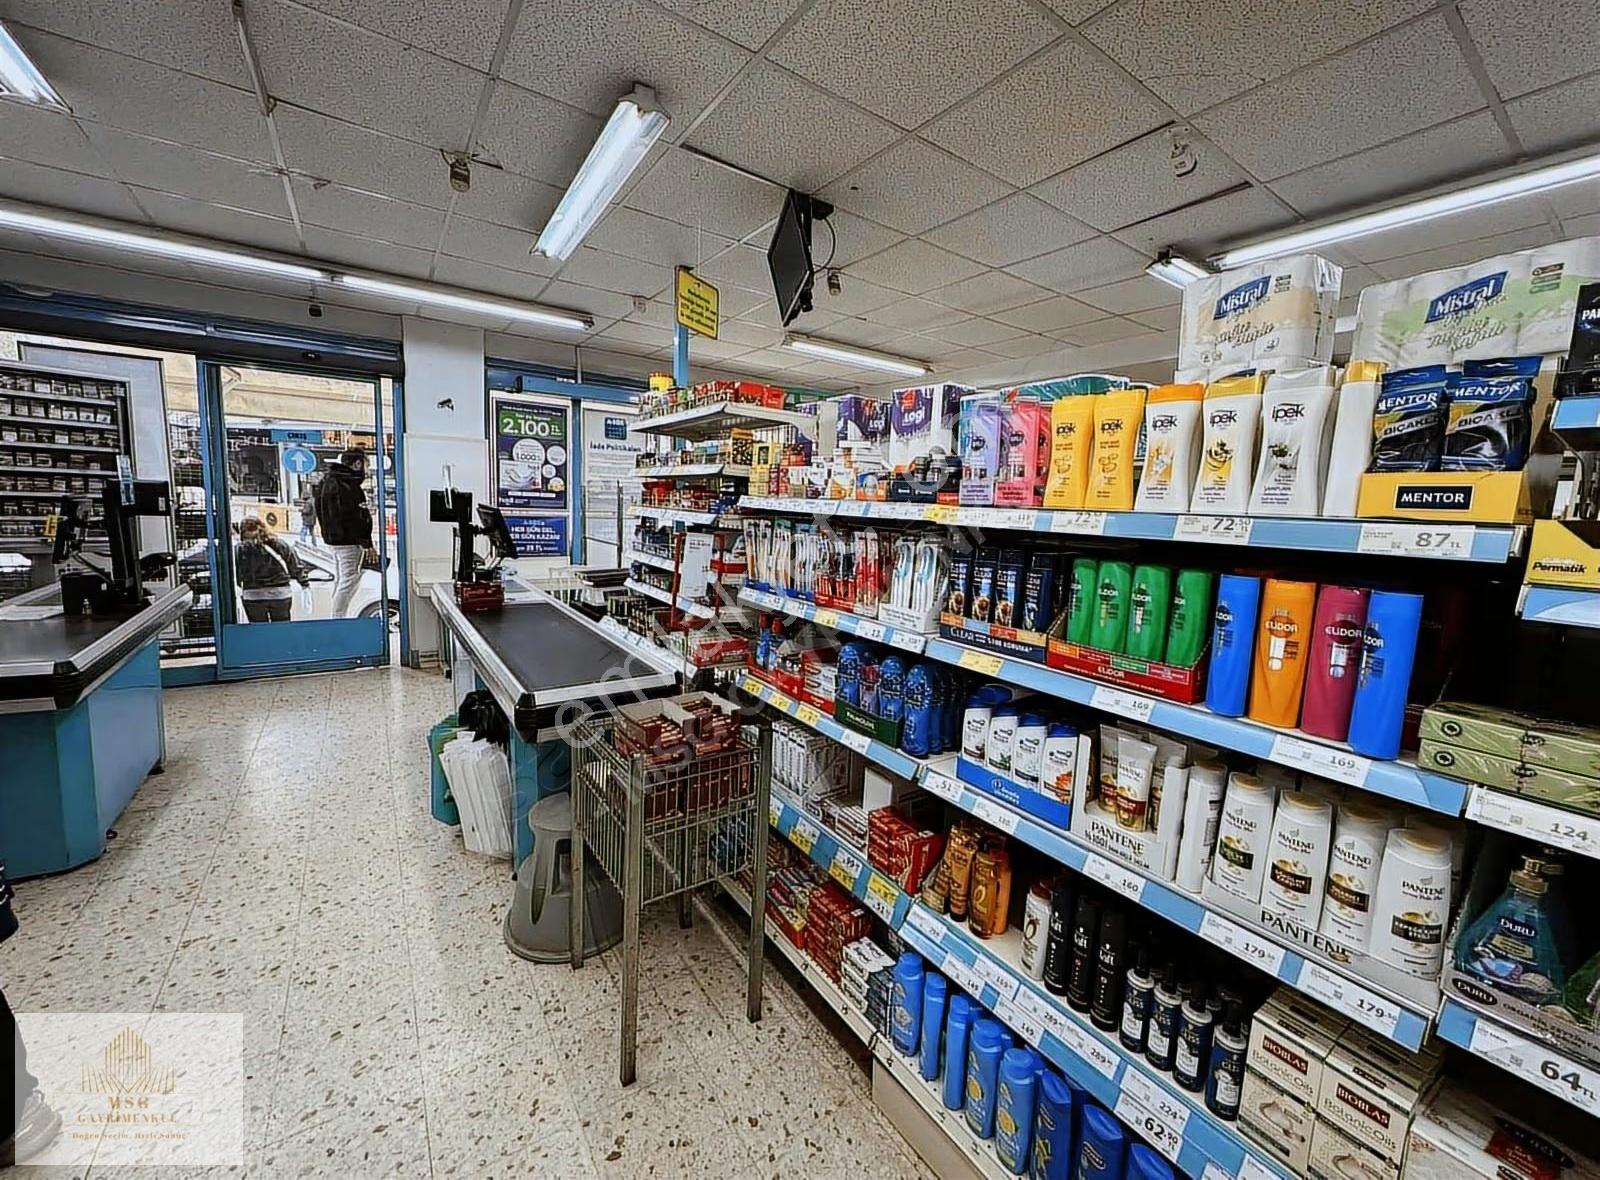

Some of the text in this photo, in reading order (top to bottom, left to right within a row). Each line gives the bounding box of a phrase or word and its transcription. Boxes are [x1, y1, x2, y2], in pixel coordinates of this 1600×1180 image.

[1221, 283, 1263, 311] Mistral
[1435, 280, 1495, 316] Mistral
[1210, 410, 1238, 427] ipek
[1272, 403, 1304, 422] ipek
[503, 418, 550, 436] 2.100
[1152, 415, 1178, 431] ipek
[1401, 492, 1465, 504] MENTOR
[1416, 532, 1451, 548] 87
[1532, 562, 1587, 574] Permatik
[1330, 755, 1356, 768] 169
[1092, 822, 1145, 854] PANTENE
[1549, 823, 1589, 842] 124
[1260, 911, 1354, 960] PANTENE
[1500, 918, 1536, 937] DURU
[1244, 942, 1266, 959] 179
[1457, 981, 1493, 1003] DURU
[1263, 1038, 1308, 1072] BIOBLAS
[1540, 1060, 1598, 1101] 64 TL
[1338, 1086, 1389, 1125] BIOBLAS
